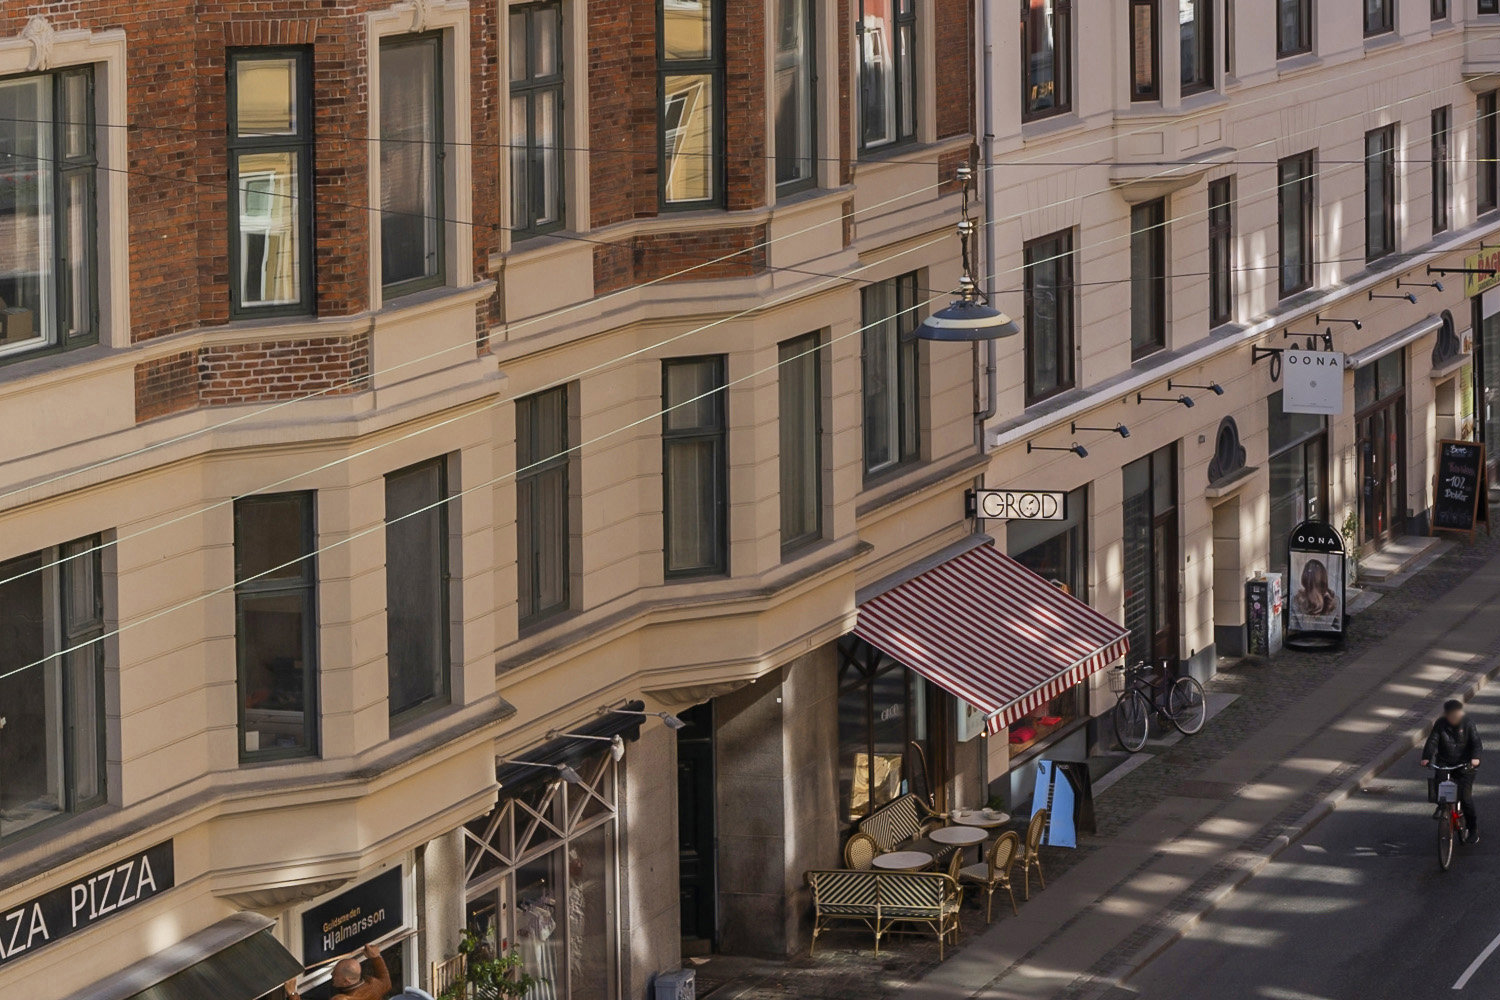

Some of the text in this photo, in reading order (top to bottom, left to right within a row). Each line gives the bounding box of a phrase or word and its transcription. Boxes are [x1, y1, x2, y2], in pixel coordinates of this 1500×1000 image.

[1289, 355, 1338, 367] OONA
[1298, 535, 1335, 545] OONA
[0, 855, 157, 960] ZA PIZZA
[323, 907, 386, 952] Hjalmarsson
